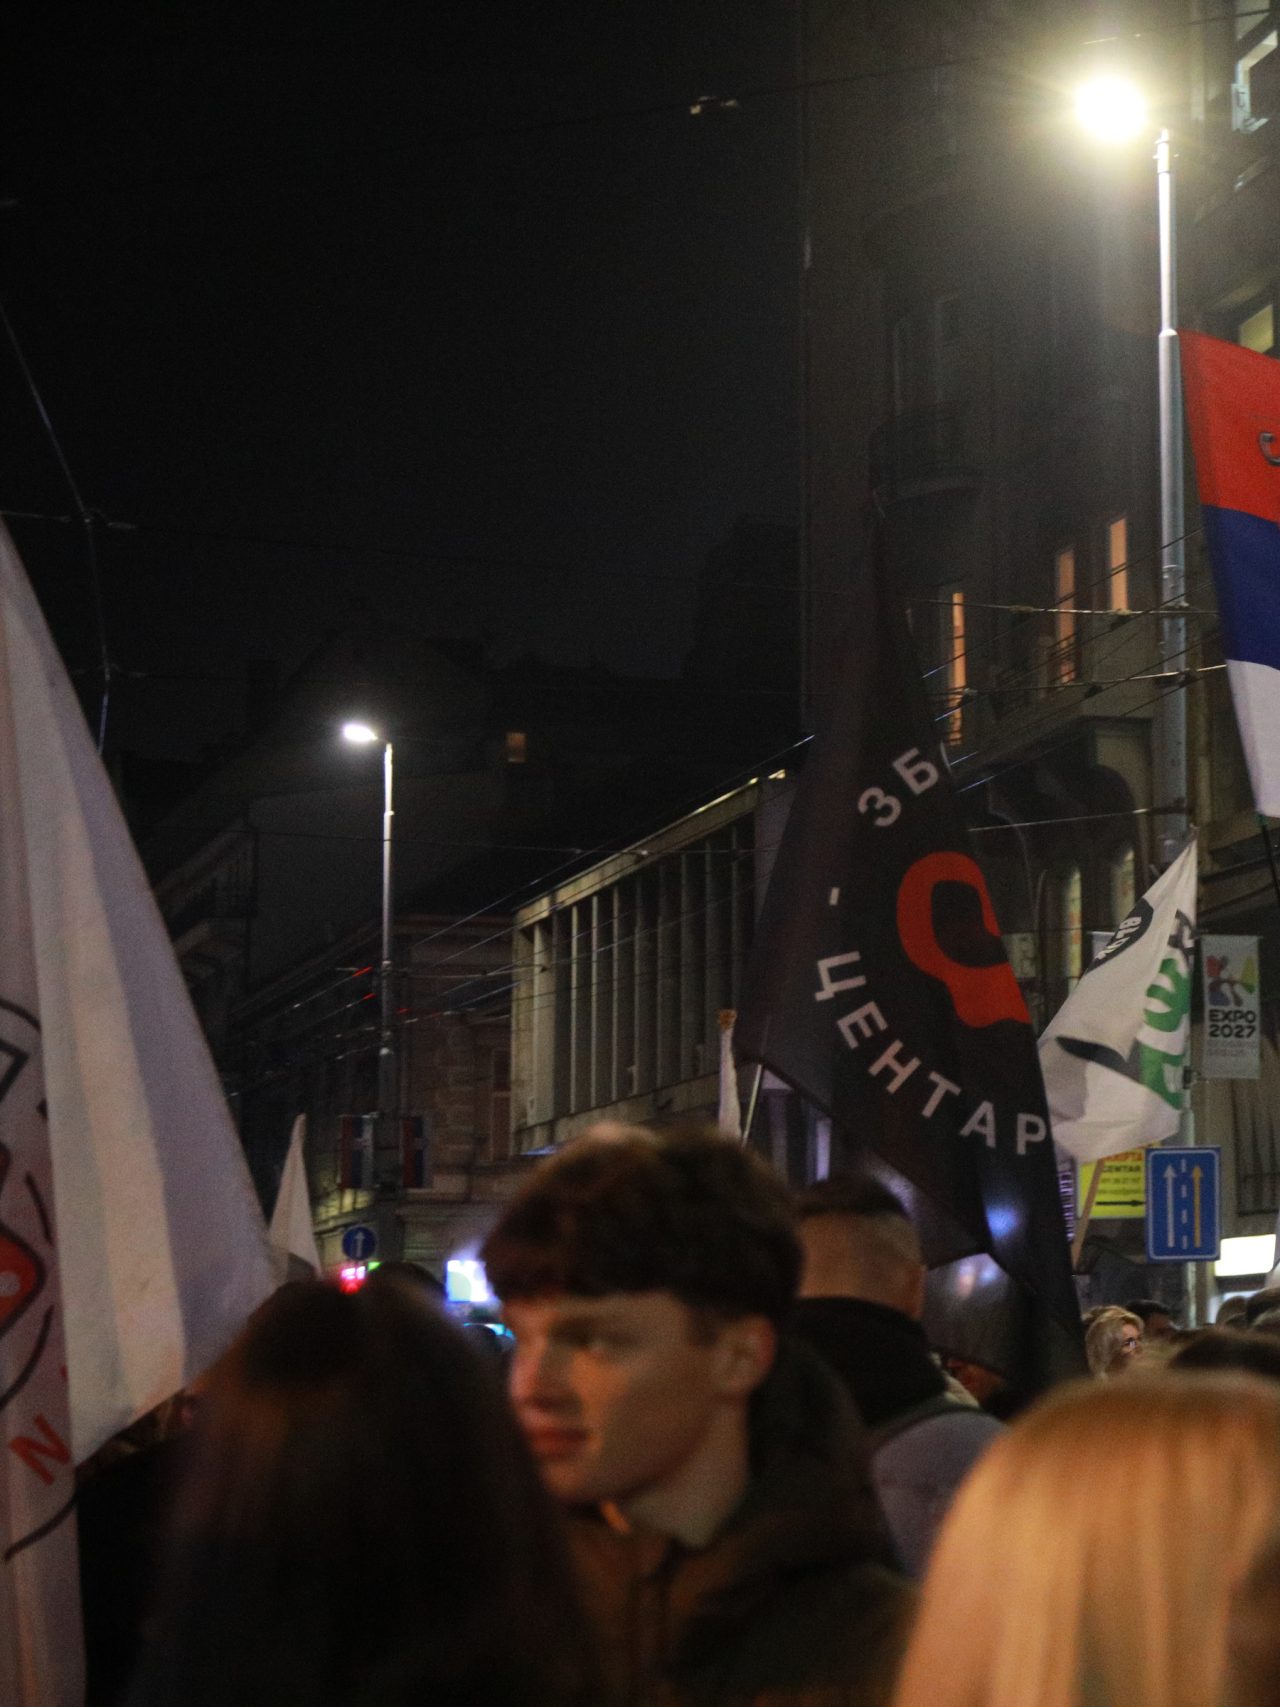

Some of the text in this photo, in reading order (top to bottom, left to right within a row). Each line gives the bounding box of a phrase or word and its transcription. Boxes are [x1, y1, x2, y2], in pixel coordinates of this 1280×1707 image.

[857, 740, 952, 827] ЗБ
[1209, 1009, 1256, 1024] EXPO
[1209, 1024, 1256, 1038] 2027
[815, 951, 1047, 1155] ЦЕНТАР
